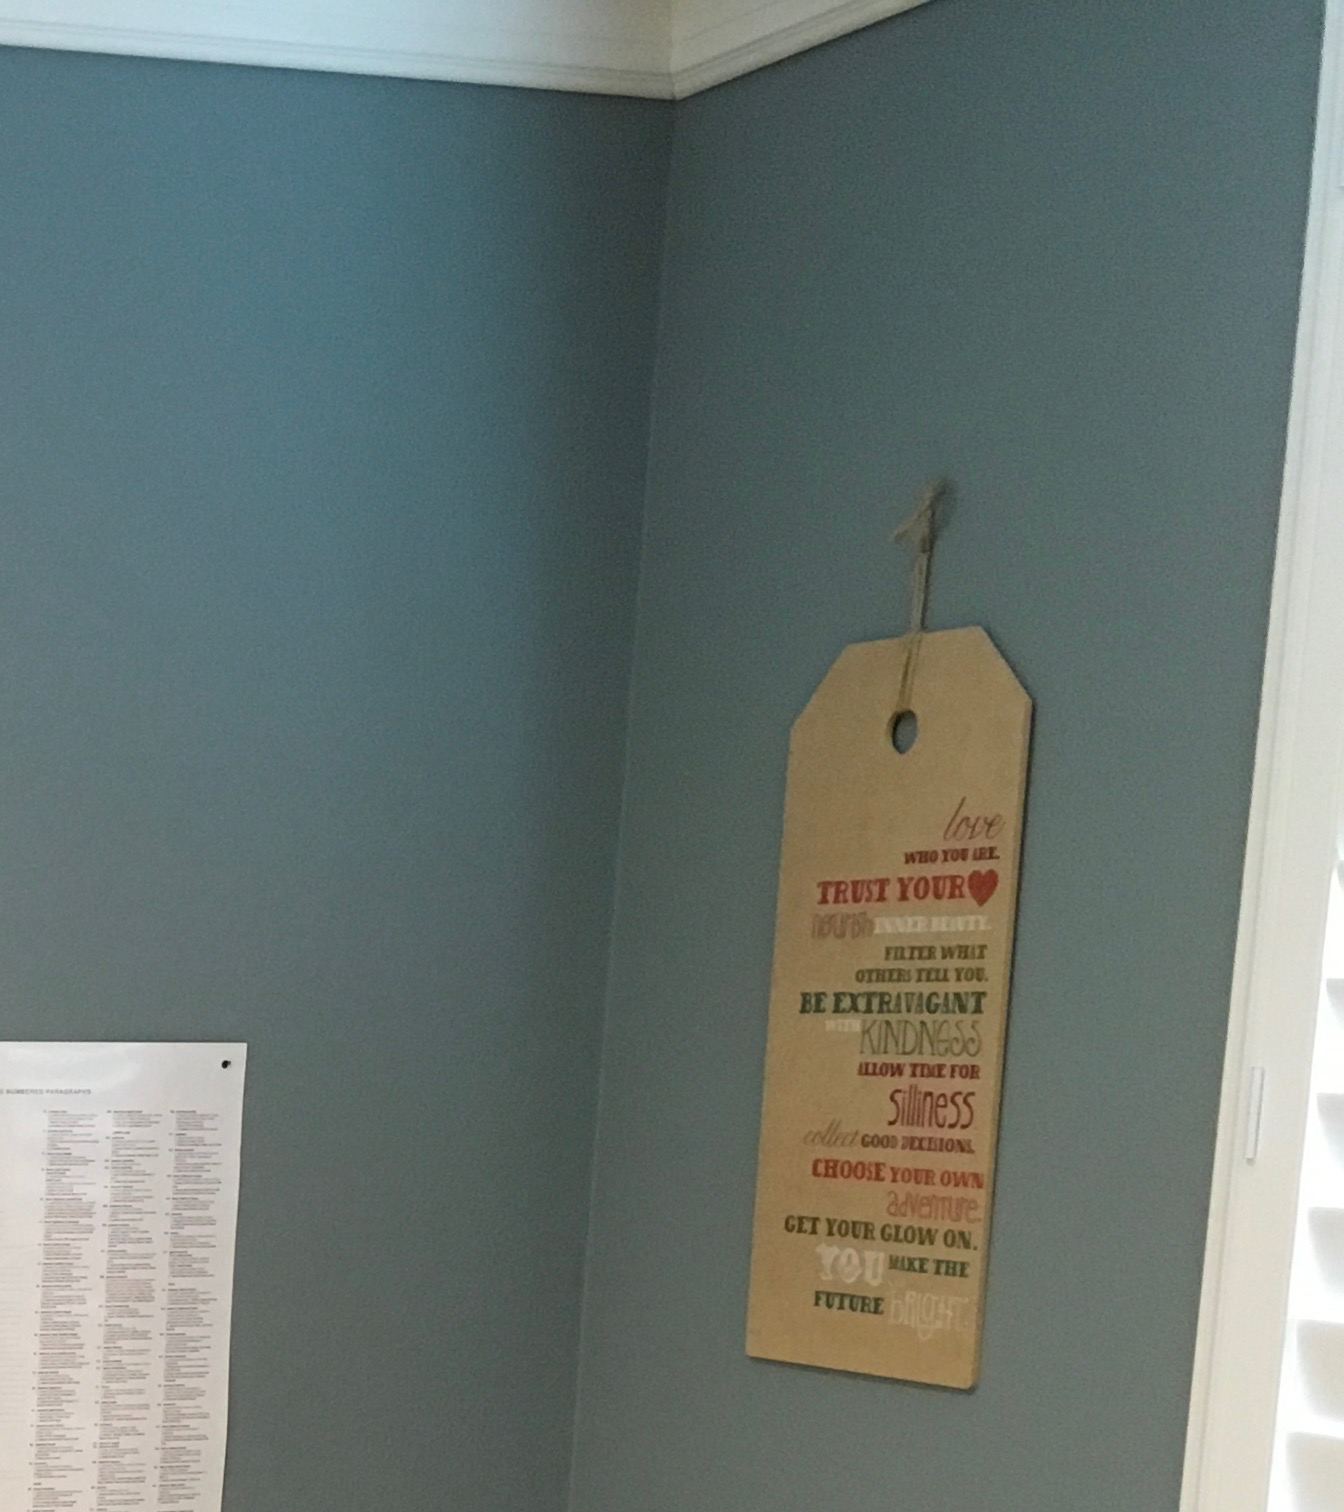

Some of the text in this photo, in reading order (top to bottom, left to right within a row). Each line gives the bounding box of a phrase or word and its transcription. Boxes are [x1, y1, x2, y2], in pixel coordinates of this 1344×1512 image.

[943, 796, 1005, 841] love
[904, 850, 938, 864] WHO
[940, 848, 969, 863] YOU
[816, 874, 966, 905] TRUST YOUR
[884, 944, 988, 961] FILTER WHAT
[855, 968, 912, 983] OTHERS
[915, 967, 950, 983] TELL
[799, 991, 988, 1014] BE EXTRAVAGANT
[857, 1061, 981, 1079] ALLOW TIME FOR
[861, 1133, 898, 1149] GOOD
[812, 1158, 984, 1189] CHOOSE YOUR OWN
[784, 1214, 978, 1251] GET YOUR GLOW ON.
[816, 1243, 969, 1286] YOU MAKE THE
[813, 1290, 885, 1315] FUTURE
